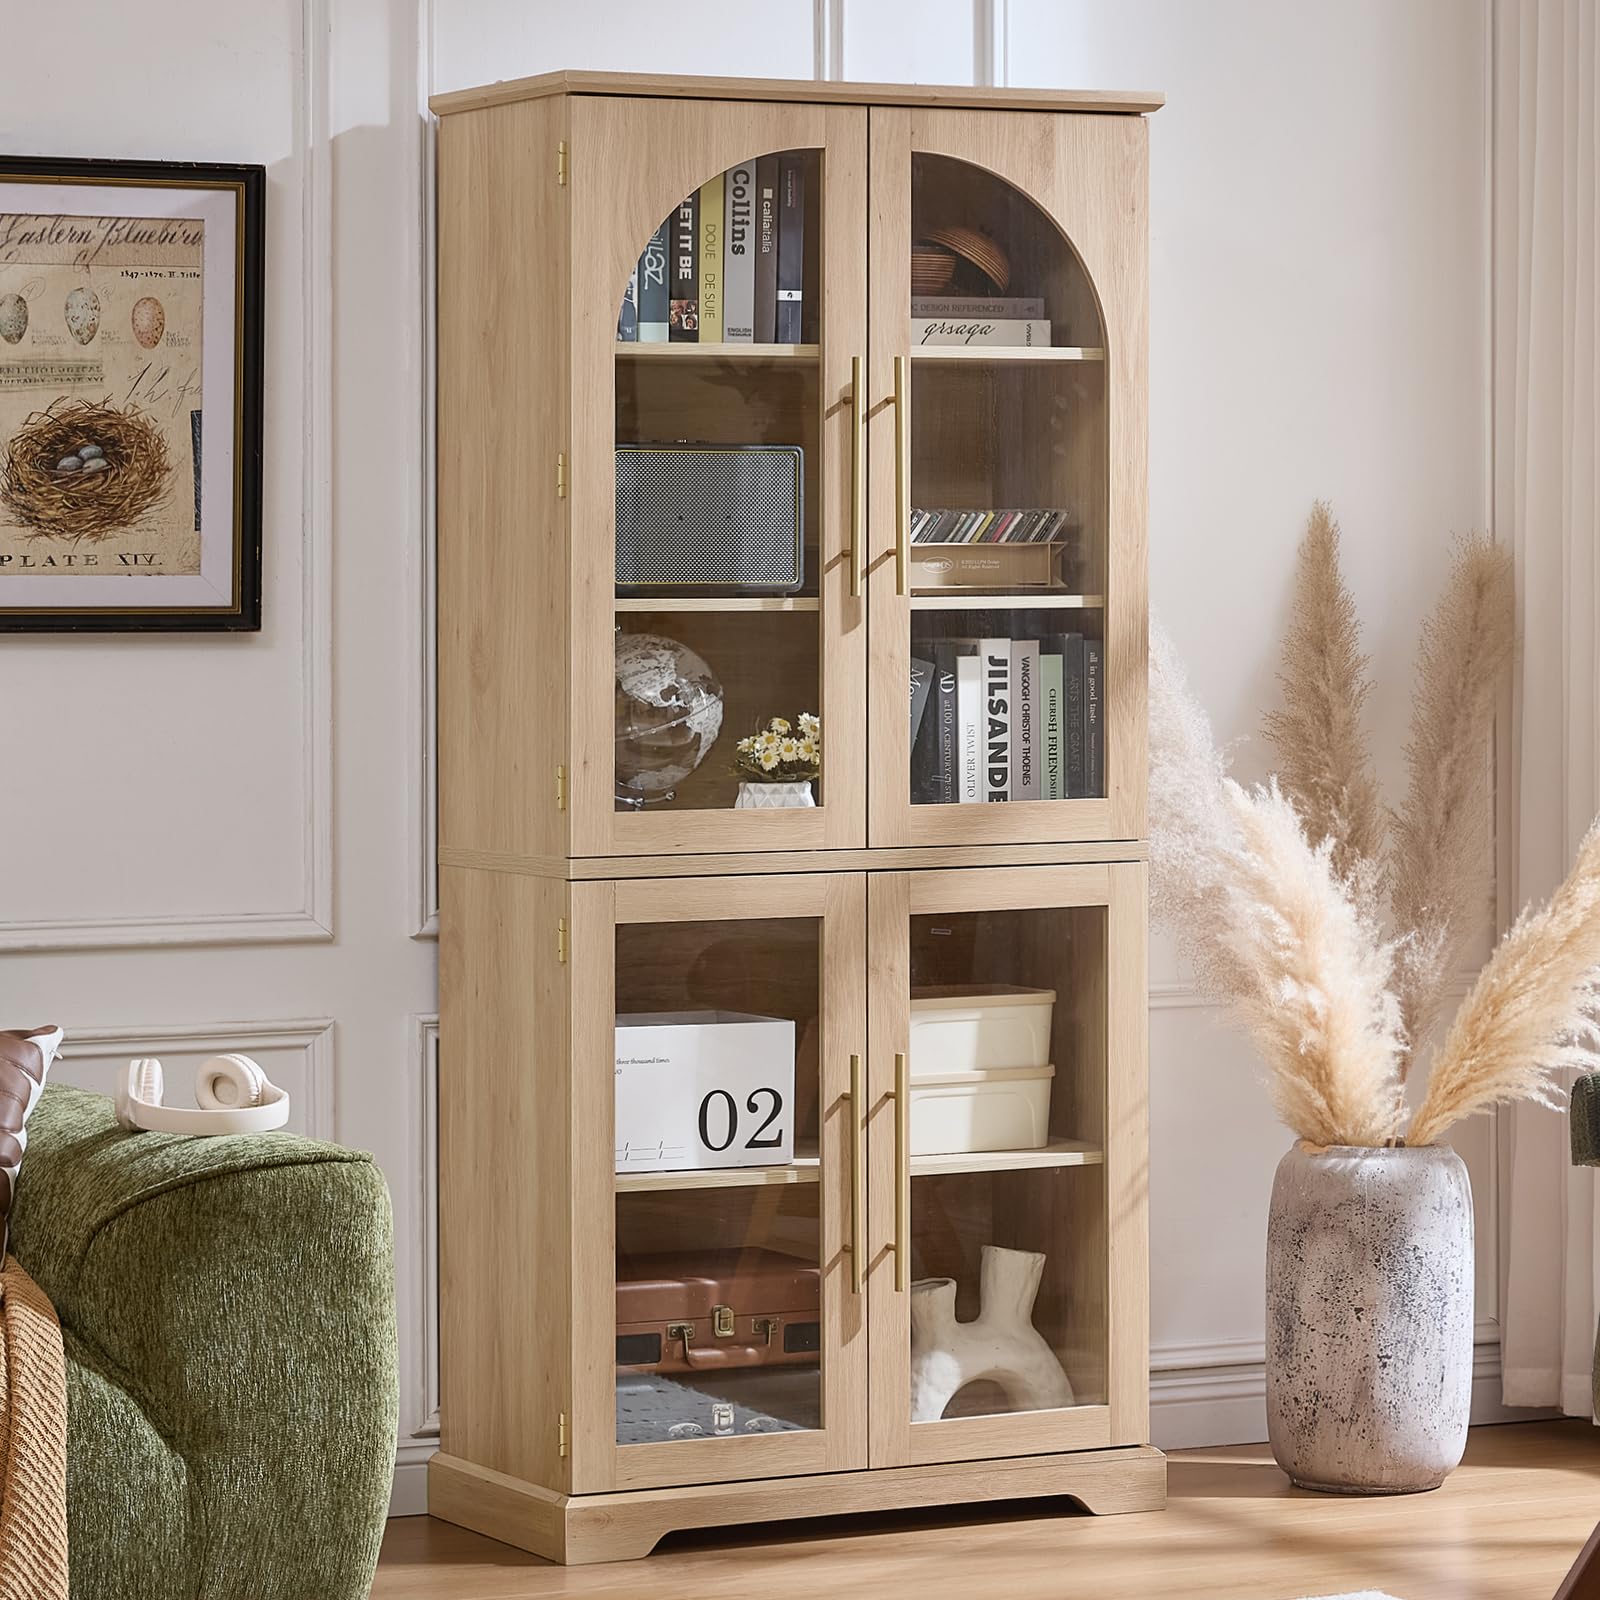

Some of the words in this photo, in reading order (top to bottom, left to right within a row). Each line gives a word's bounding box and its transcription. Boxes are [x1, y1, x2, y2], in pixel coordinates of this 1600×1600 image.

[680, 198, 692, 230] LET
[731, 169, 750, 256] Collins
[679, 235, 692, 251] IT
[705, 224, 716, 260] DOUE
[679, 256, 692, 280] BE
[705, 273, 716, 289] DE
[704, 290, 715, 319] SUIE
[920, 303, 949, 312] DESIGN
[951, 303, 1005, 313] REFERENCED
[0, 555, 98, 568] PLATE
[940, 670, 955, 693] AD
[1021, 656, 1031, 701] VANGOGH
[1090, 666, 1097, 674] in
[1088, 677, 1098, 701] good
[1022, 703, 1031, 744] CHRISTOF
[1048, 688, 1058, 732] CHERISH
[1089, 704, 1098, 724] taste
[967, 722, 976, 758] TWIST
[967, 759, 976, 798] OLIVER
[1022, 745, 1031, 786] THOENES
[1048, 736, 1058, 800] FRIENDSHI
[698, 1087, 783, 1151] 02
